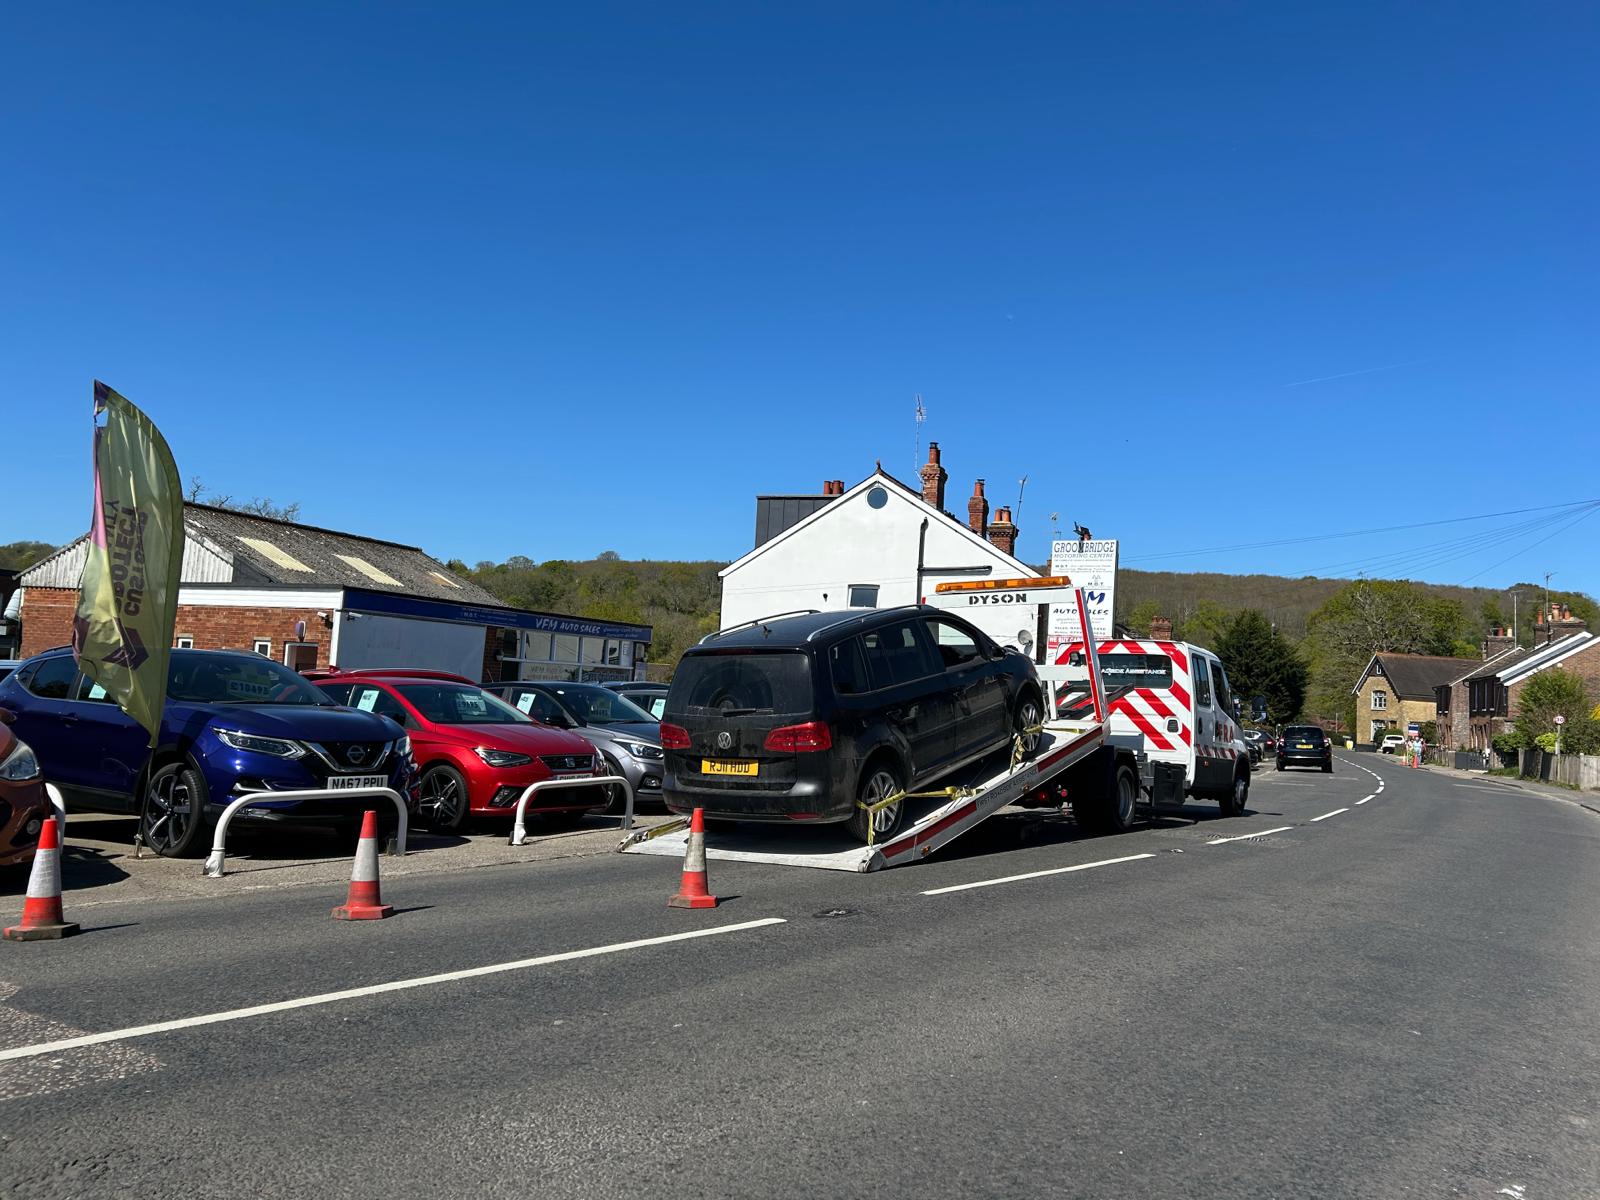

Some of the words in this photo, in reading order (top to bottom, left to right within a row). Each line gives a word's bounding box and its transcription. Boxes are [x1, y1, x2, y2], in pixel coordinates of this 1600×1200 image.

[969, 594, 1027, 605] DYSON
[536, 618, 558, 631] VFM
[560, 622, 579, 631] AUTO
[580, 624, 600, 634] SALES
[709, 760, 728, 773] RJ11
[731, 761, 750, 773] HDD
[332, 778, 361, 789] NA67
